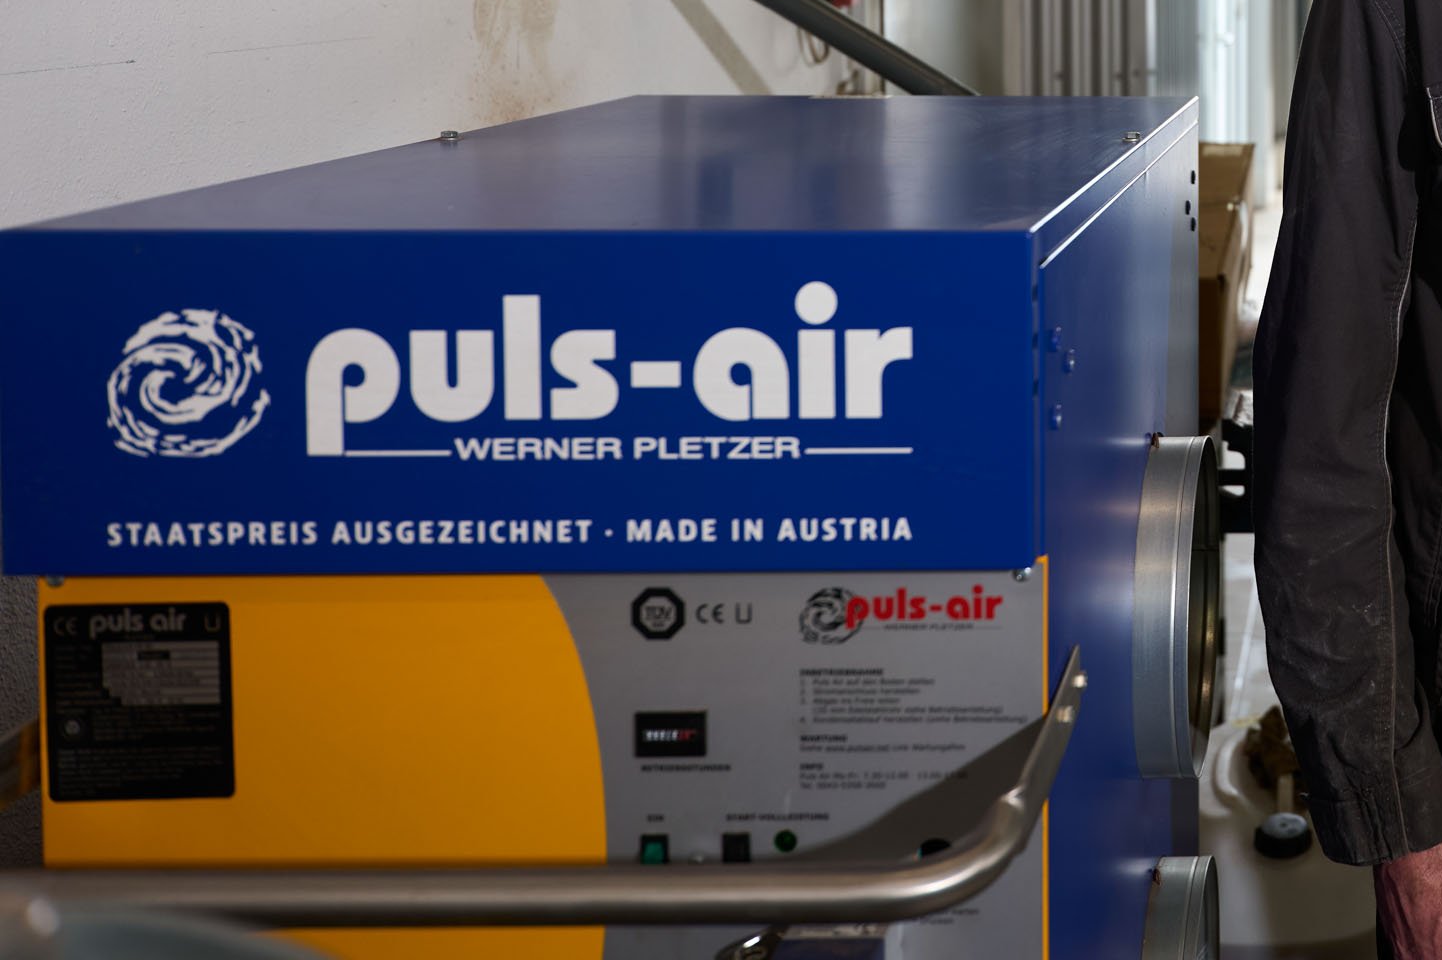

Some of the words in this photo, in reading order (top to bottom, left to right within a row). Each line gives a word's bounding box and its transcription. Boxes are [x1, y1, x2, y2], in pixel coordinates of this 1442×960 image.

[306, 282, 912, 456] puls-air
[455, 438, 621, 459] WERNER
[634, 437, 800, 459] PLETZER
[109, 521, 317, 546] STAATSPREIS
[332, 519, 592, 544] AUSGEZEICHNET
[627, 518, 717, 542] MADE
[731, 518, 763, 542] IN
[777, 517, 912, 542] AUSTRIA
[845, 584, 1003, 629] puls-air
